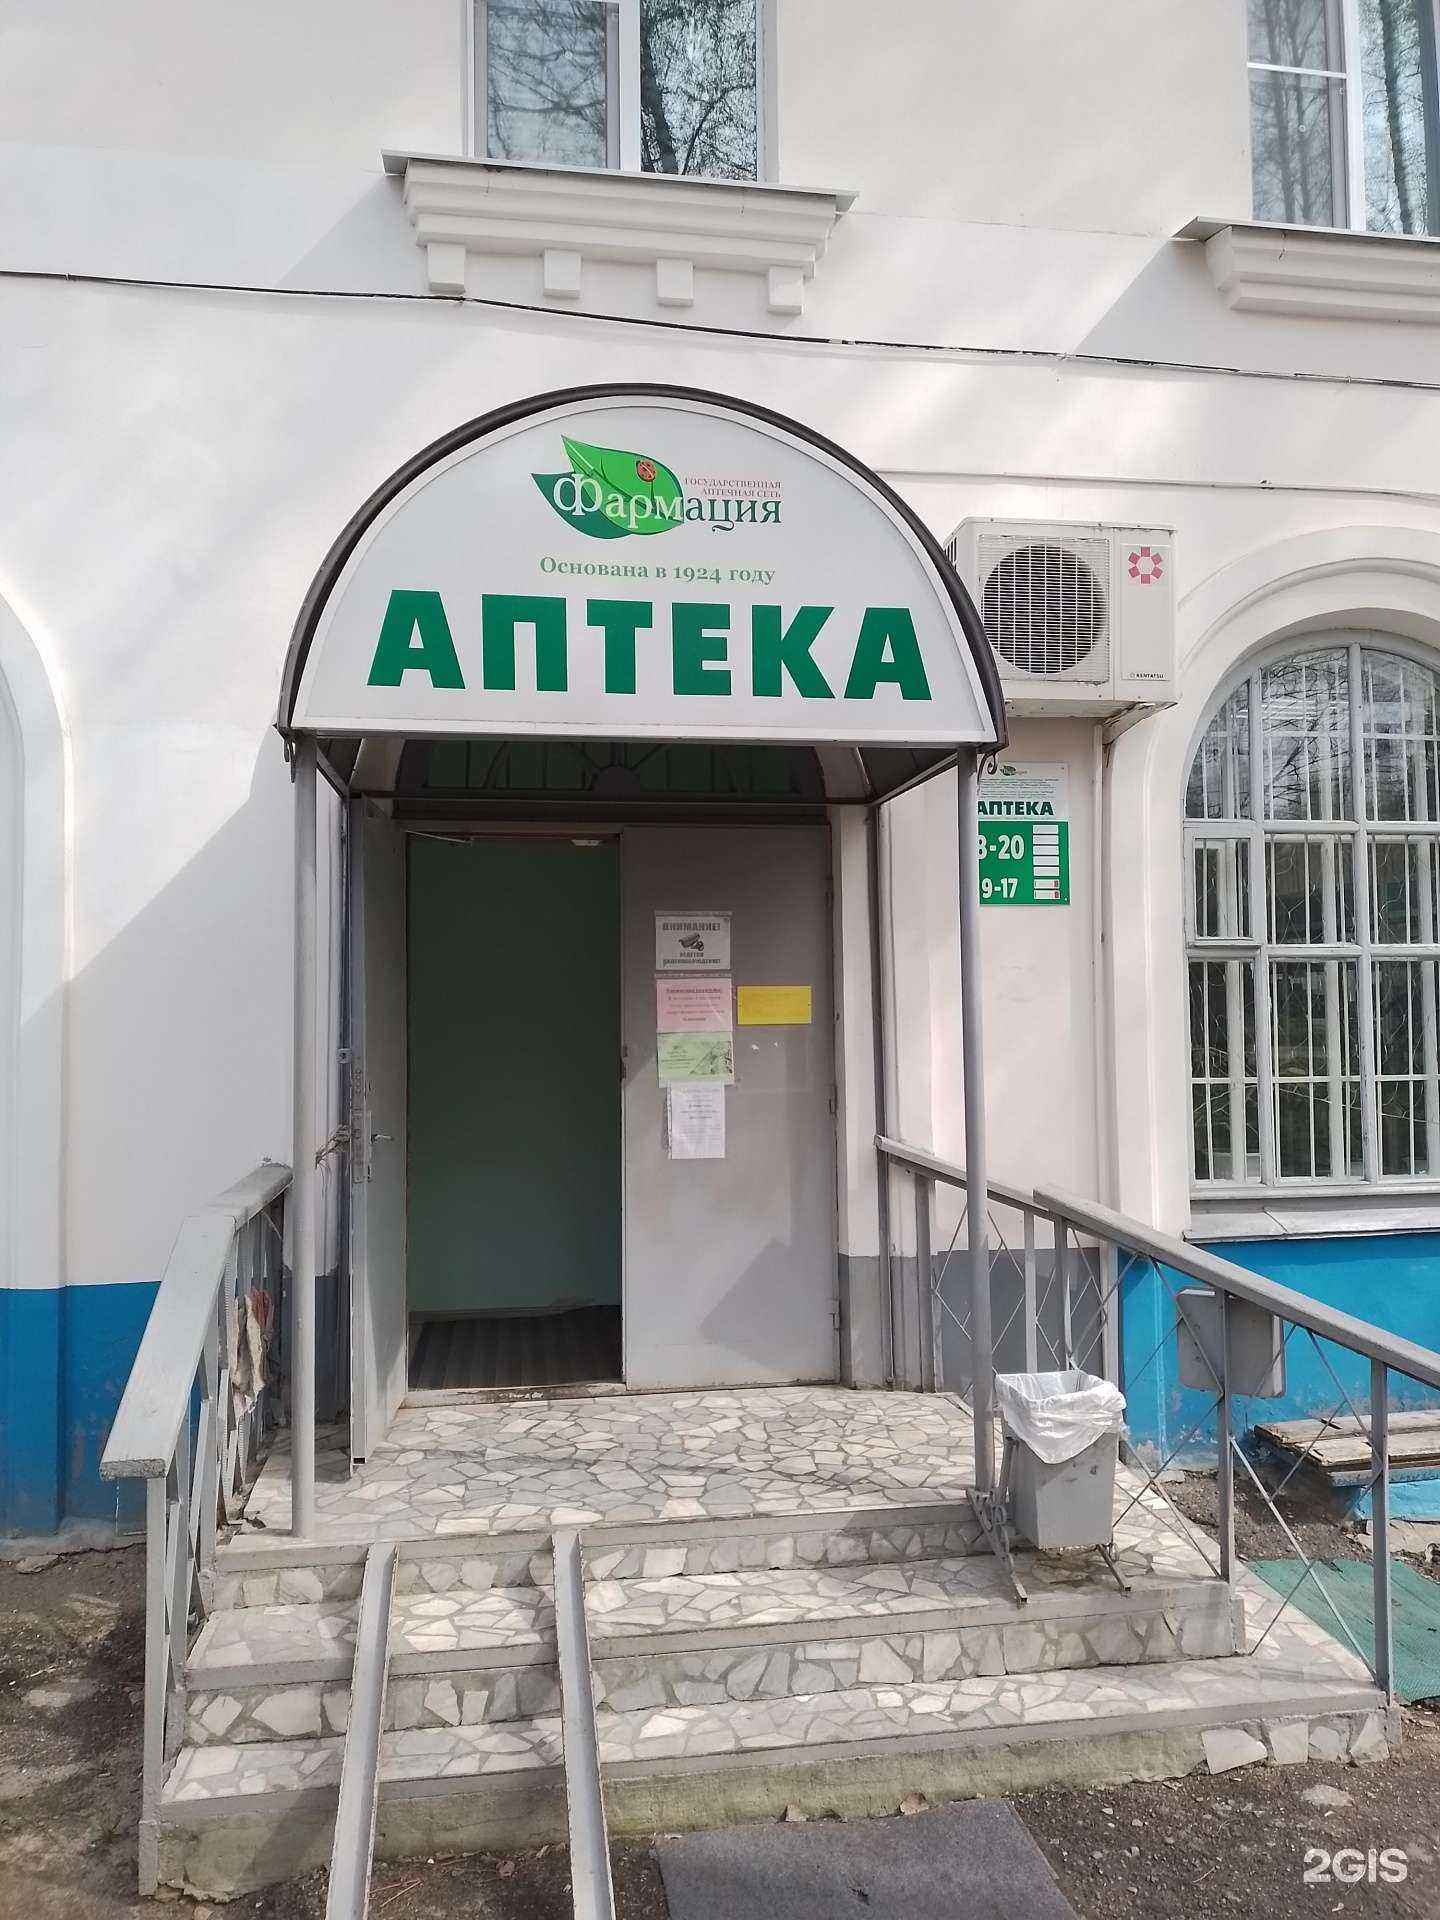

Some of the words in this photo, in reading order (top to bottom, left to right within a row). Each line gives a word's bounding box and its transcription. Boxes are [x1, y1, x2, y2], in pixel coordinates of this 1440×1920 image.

[685, 477, 782, 489] ГОСУДАРСТВЕННАЯ
[703, 488, 754, 497] АПТЕЧНАЯ
[757, 490, 781, 498] СЕТЬ
[553, 473, 782, 532] Фармация
[539, 556, 648, 578] Основана
[656, 567, 667, 578] в
[672, 566, 722, 584] 1924
[729, 568, 776, 585] году
[366, 589, 933, 701] АПТЕКА
[978, 801, 1054, 816] АПТЕКА
[981, 877, 1018, 899] 9-17
